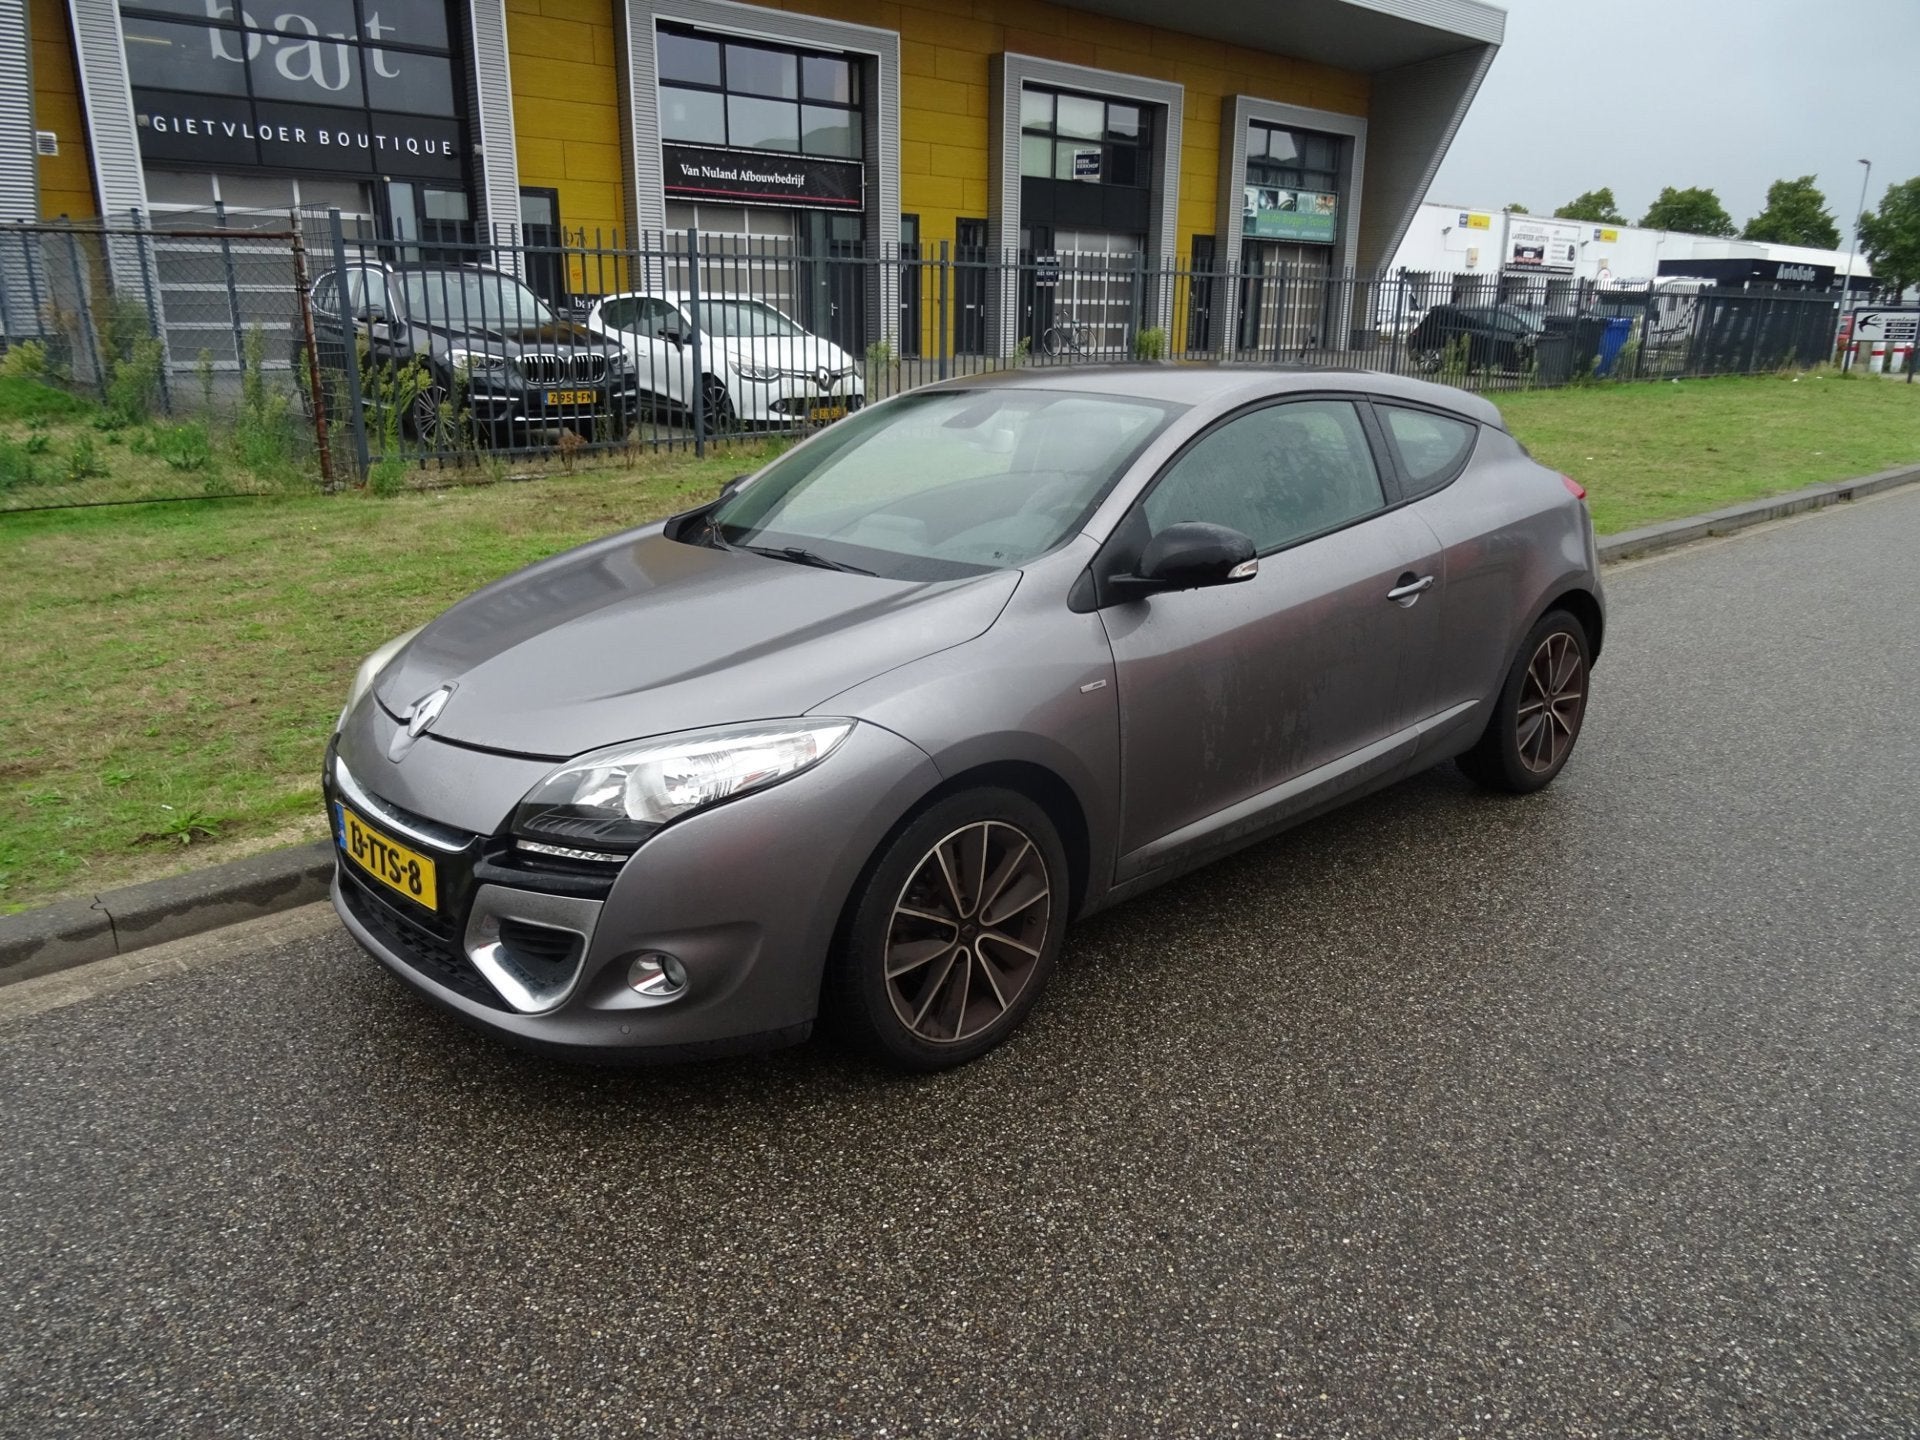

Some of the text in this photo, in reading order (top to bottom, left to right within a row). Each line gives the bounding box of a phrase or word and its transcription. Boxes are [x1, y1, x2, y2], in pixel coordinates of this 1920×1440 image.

[153, 115, 452, 155] GIETVLOER BOUTIQUE
[680, 164, 805, 188] Van Nuland Afbouwbedrijf
